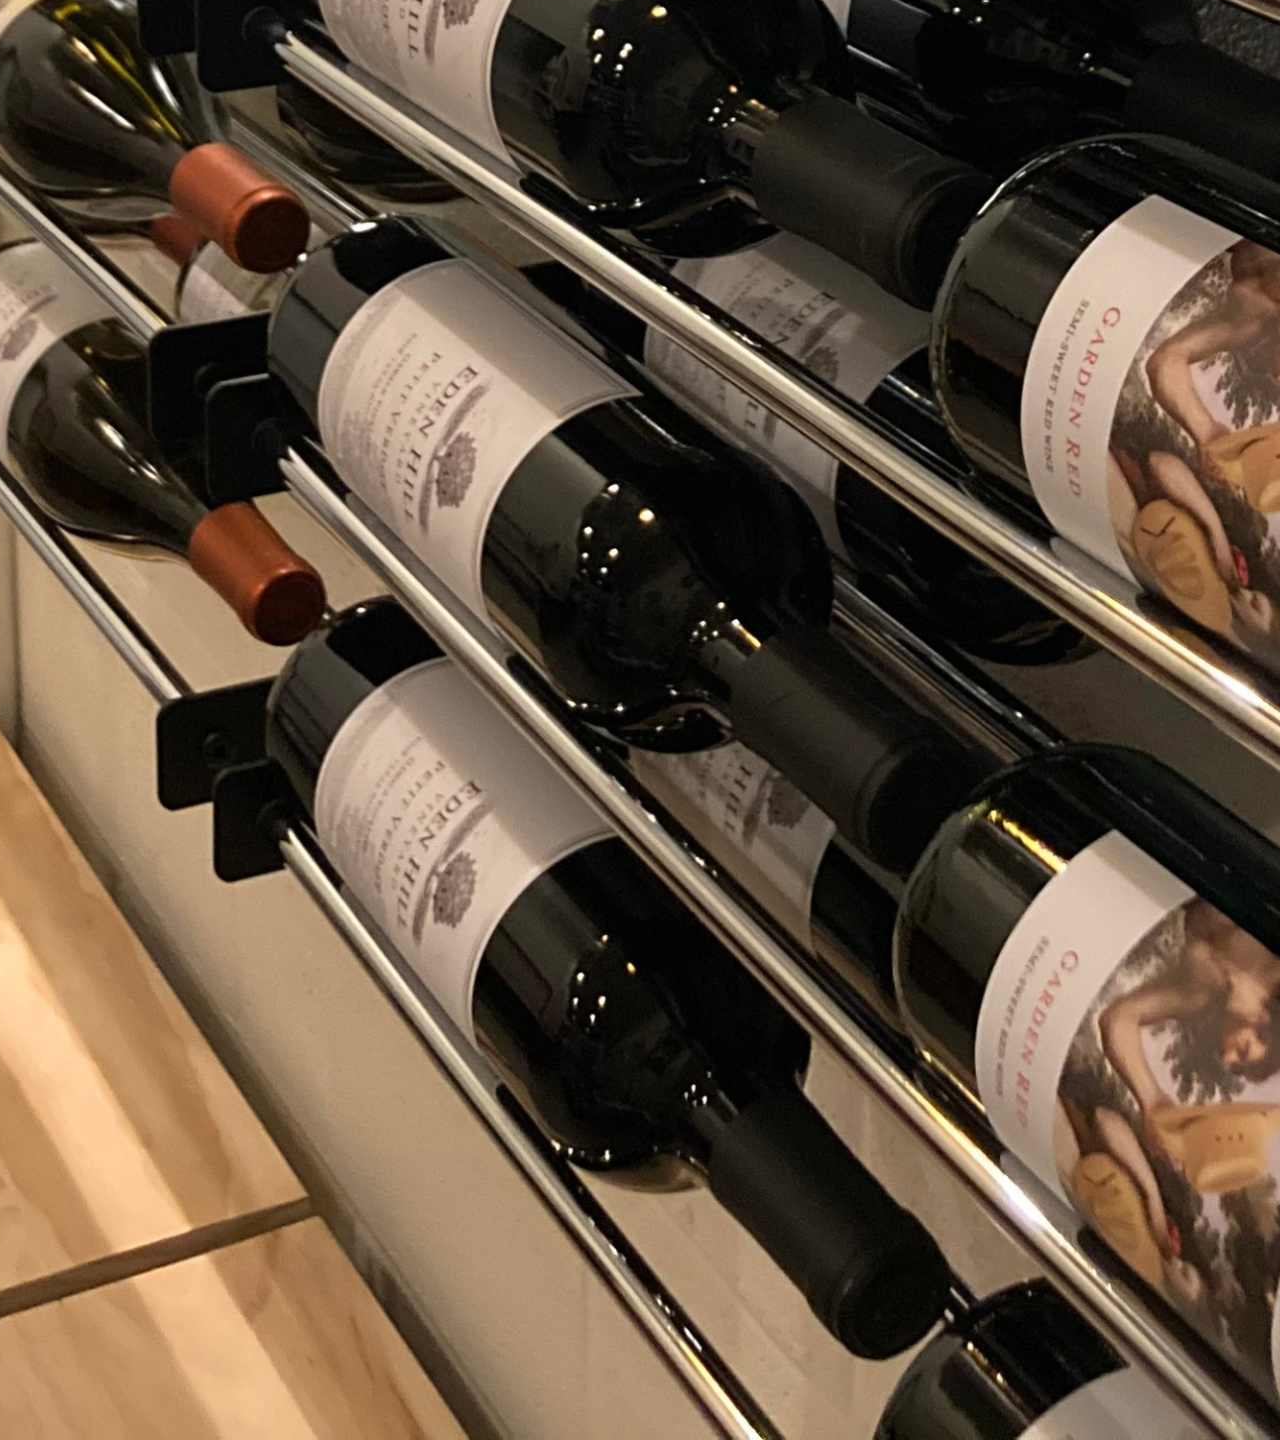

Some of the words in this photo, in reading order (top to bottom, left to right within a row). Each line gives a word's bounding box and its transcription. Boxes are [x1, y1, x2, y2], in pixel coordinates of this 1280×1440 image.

[1046, 299, 1089, 396] SEMI-SWEET
[1065, 305, 1122, 429] GARDEN
[418, 363, 480, 441] EDEN
[1042, 397, 1056, 430] RED
[403, 447, 423, 522] HILL
[1041, 432, 1056, 474] WINE
[1064, 437, 1083, 499] RED
[418, 779, 483, 852] EDEN
[396, 855, 421, 929] HILL
[1018, 949, 1079, 1073] GARDEN
[1016, 1073, 1031, 1130] RED
